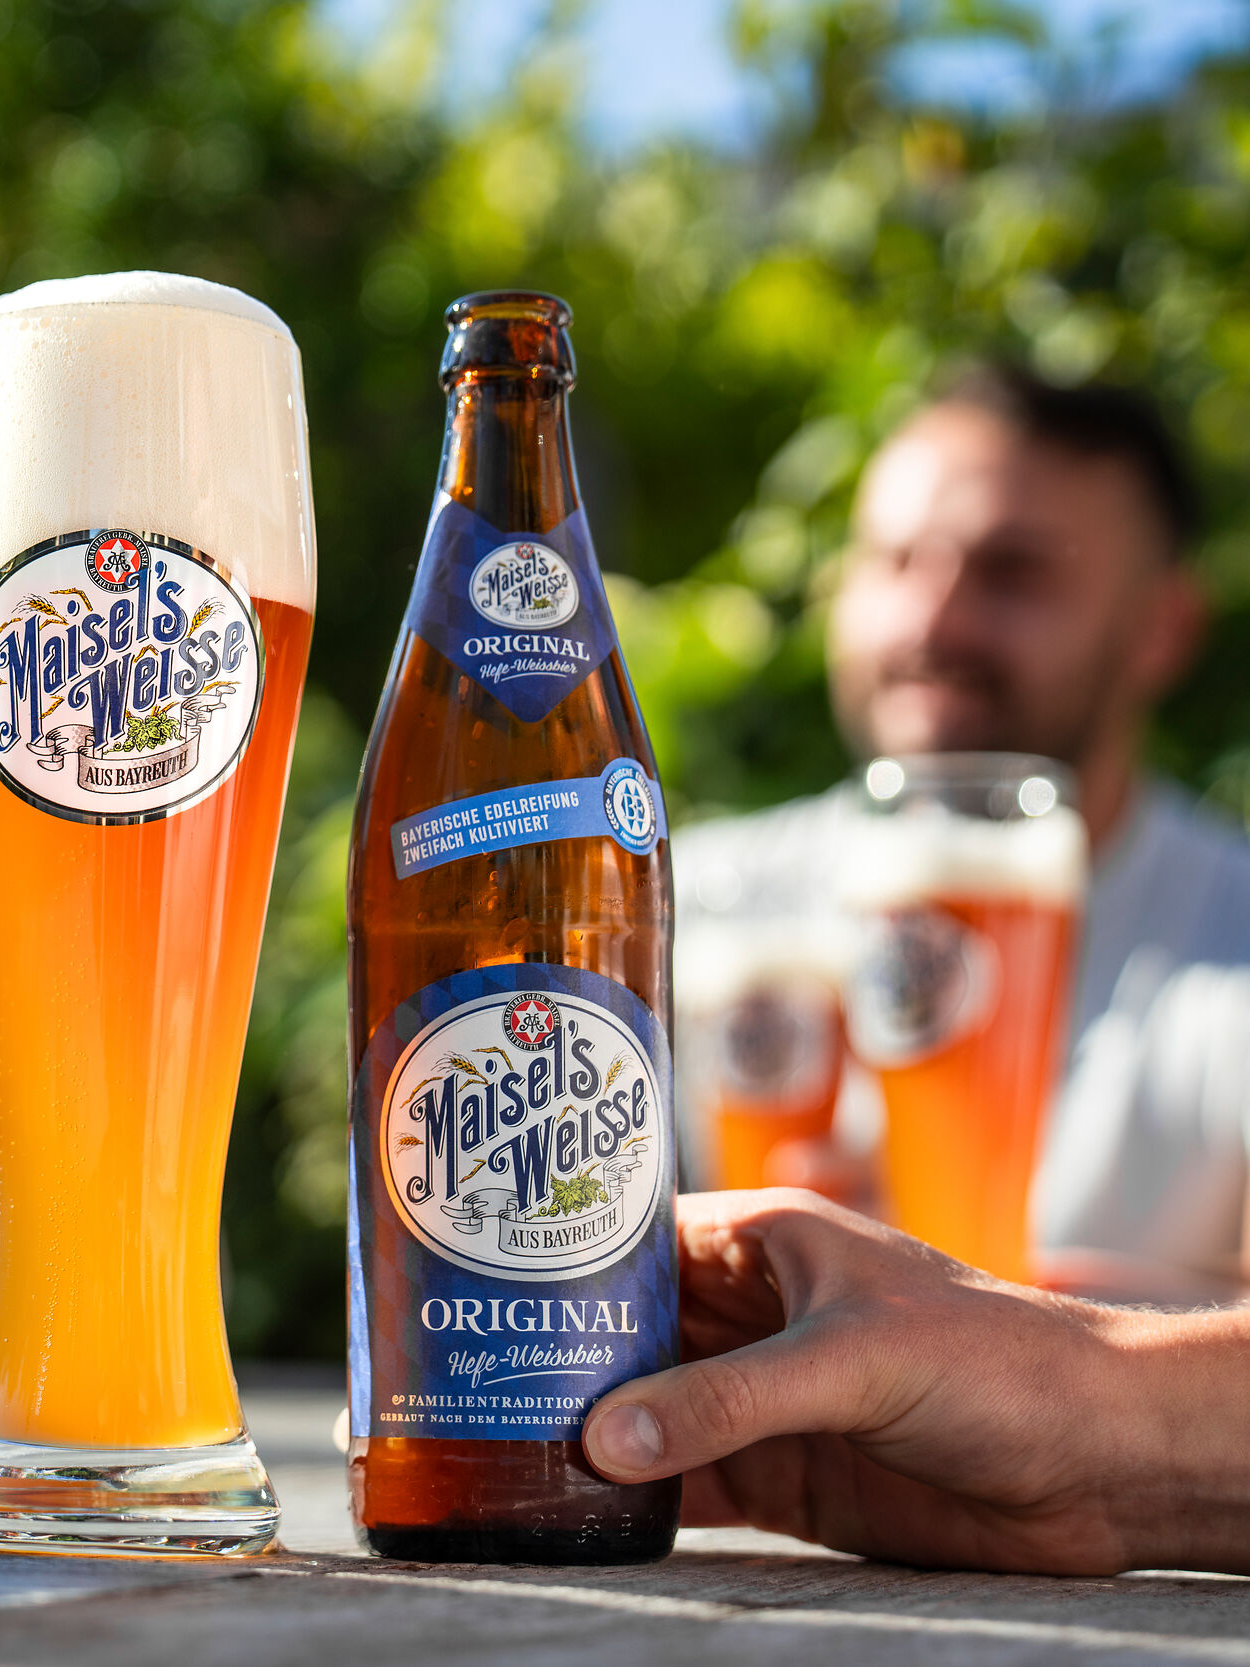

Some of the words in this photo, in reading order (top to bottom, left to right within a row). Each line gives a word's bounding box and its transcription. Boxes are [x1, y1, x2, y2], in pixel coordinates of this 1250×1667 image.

[90, 567, 123, 592] BAYREUTH
[481, 551, 549, 609] Maisel's
[511, 571, 569, 609] Weisse
[463, 634, 591, 662] ORIGINAL
[69, 620, 248, 749] Weisse
[479, 658, 579, 685] Hefe-Weissbier
[84, 768, 113, 787] AUS
[115, 749, 188, 786] BAYREUTH
[401, 808, 480, 847] BAYERISCHE
[484, 791, 579, 822] EDELREIFUNG
[403, 832, 465, 866] ZWEIFACH
[469, 814, 549, 844] KULTIVIERT
[506, 1029, 540, 1051] BAYREUTH
[406, 1019, 602, 1206] Maisel's
[488, 1077, 650, 1215] Weisse
[508, 1229, 539, 1249] AUS
[543, 1207, 618, 1249] BAYREUTH
[421, 1298, 639, 1336] ORIGINAL
[448, 1343, 615, 1389] Hefe-Weissbier
[380, 1413, 425, 1422] GEBRAUT
[430, 1415, 462, 1423] NACH
[468, 1415, 495, 1424] DEM
[408, 1394, 586, 1409] FAMILIENTRADITION
